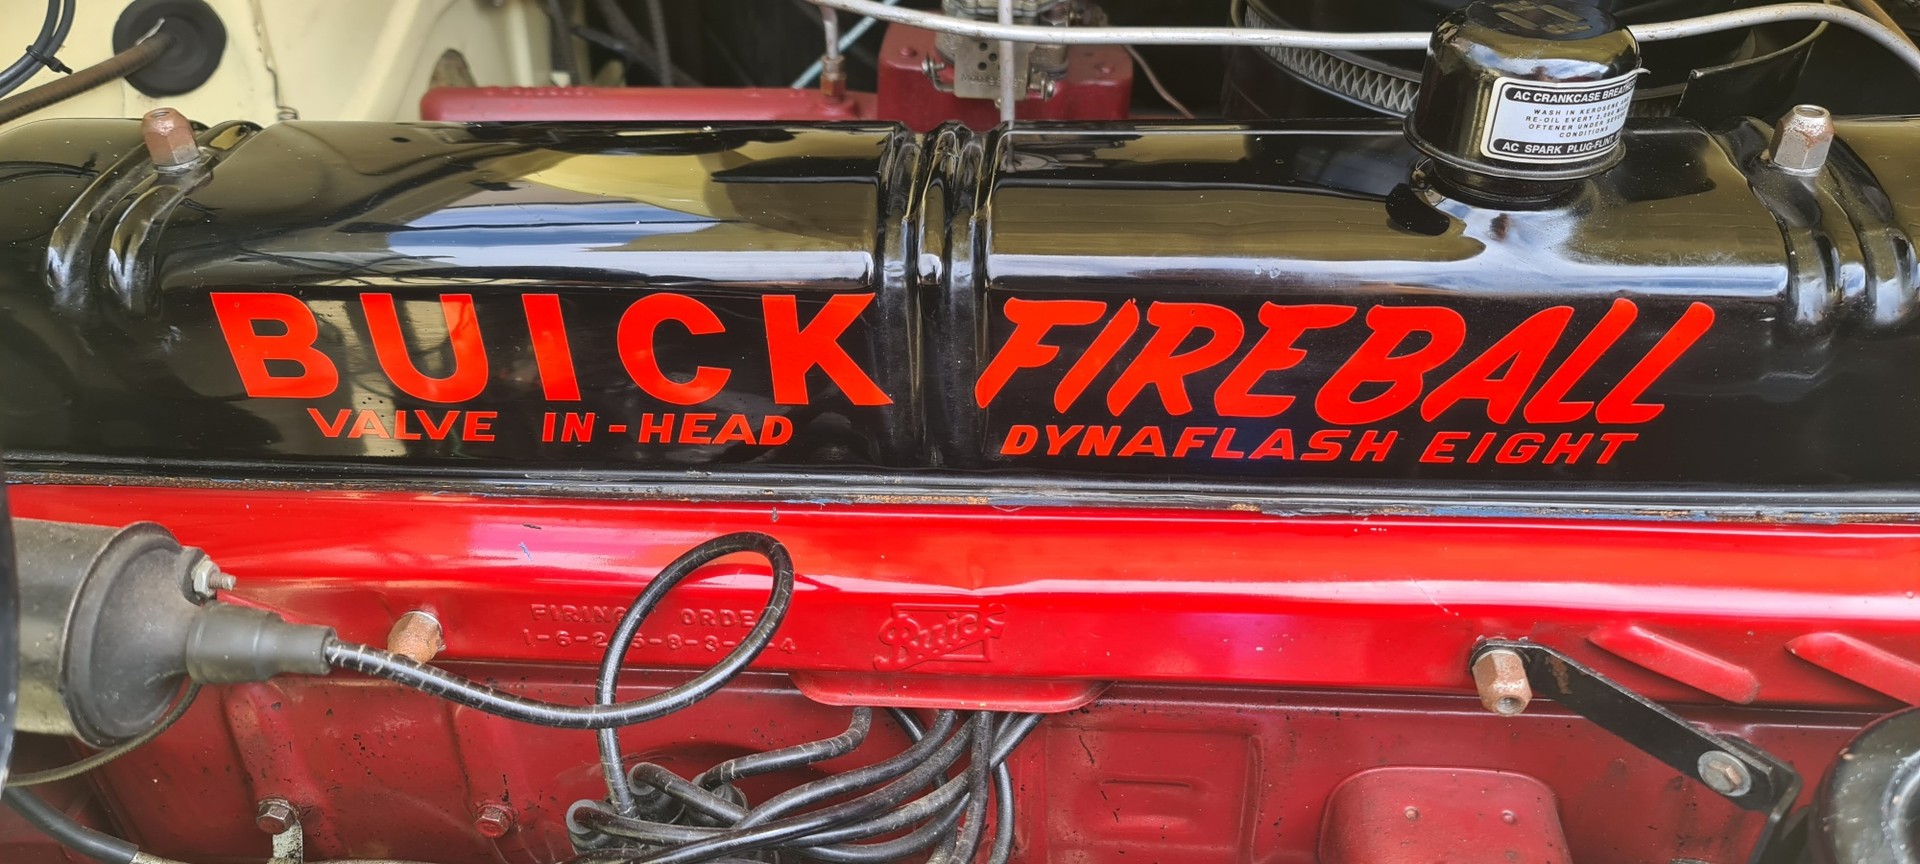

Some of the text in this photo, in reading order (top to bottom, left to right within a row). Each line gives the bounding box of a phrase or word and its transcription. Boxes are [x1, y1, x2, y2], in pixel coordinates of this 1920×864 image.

[1513, 90, 1531, 101] AC
[1533, 91, 1601, 103] CRANKCASE
[1580, 101, 1619, 115] KEROSENE
[1525, 115, 1560, 124] RE-OIL
[1564, 115, 1593, 123] EVERY
[1528, 123, 1574, 131] OFTENER
[1577, 120, 1604, 130] UNDER
[1559, 125, 1609, 138] CONDITIONS
[1502, 141, 1520, 152] AC
[1524, 144, 1563, 154] SPARK
[210, 292, 893, 406] BUICK
[975, 298, 1716, 425] FIREBALL
[307, 407, 498, 442] VALVE
[1000, 424, 1639, 465] DYNAFLASH EIGHT
[680, 607, 757, 627] ORDE
[873, 602, 1007, 672] Buick
